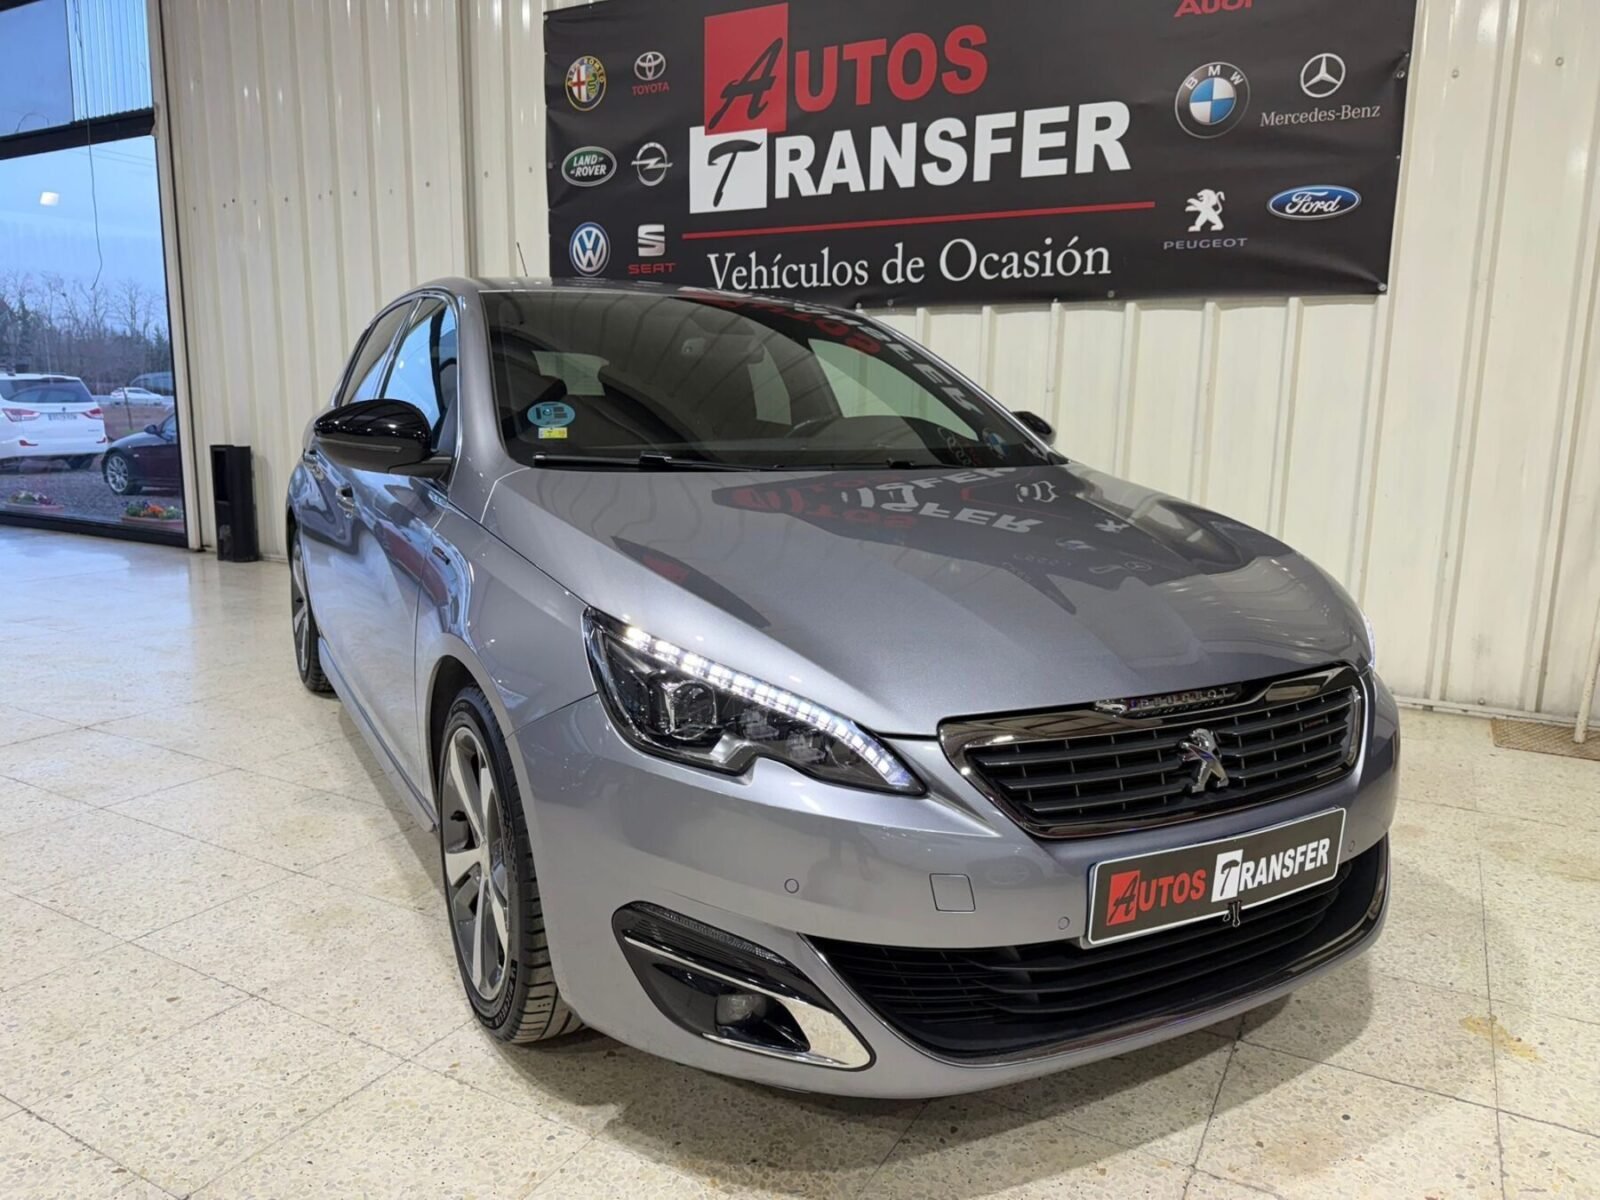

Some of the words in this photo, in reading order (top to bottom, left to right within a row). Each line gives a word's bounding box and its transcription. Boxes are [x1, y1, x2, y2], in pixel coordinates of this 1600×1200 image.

[632, 82, 670, 96] TOYOTA
[708, 25, 988, 130] AUTOS
[1185, 65, 1244, 90] BMW
[1260, 105, 1381, 127] Mercedes-Benz
[707, 101, 1132, 207] TRANSFER
[1285, 191, 1341, 214] Ford
[1163, 238, 1248, 250] PEUGEOT
[628, 263, 677, 275] SEAT
[707, 246, 869, 290] Vehículos
[881, 242, 925, 284] de
[939, 236, 1112, 282] Ocasión
[1108, 869, 1206, 923] AUTOS
[1220, 838, 1331, 897] TRANSFER
